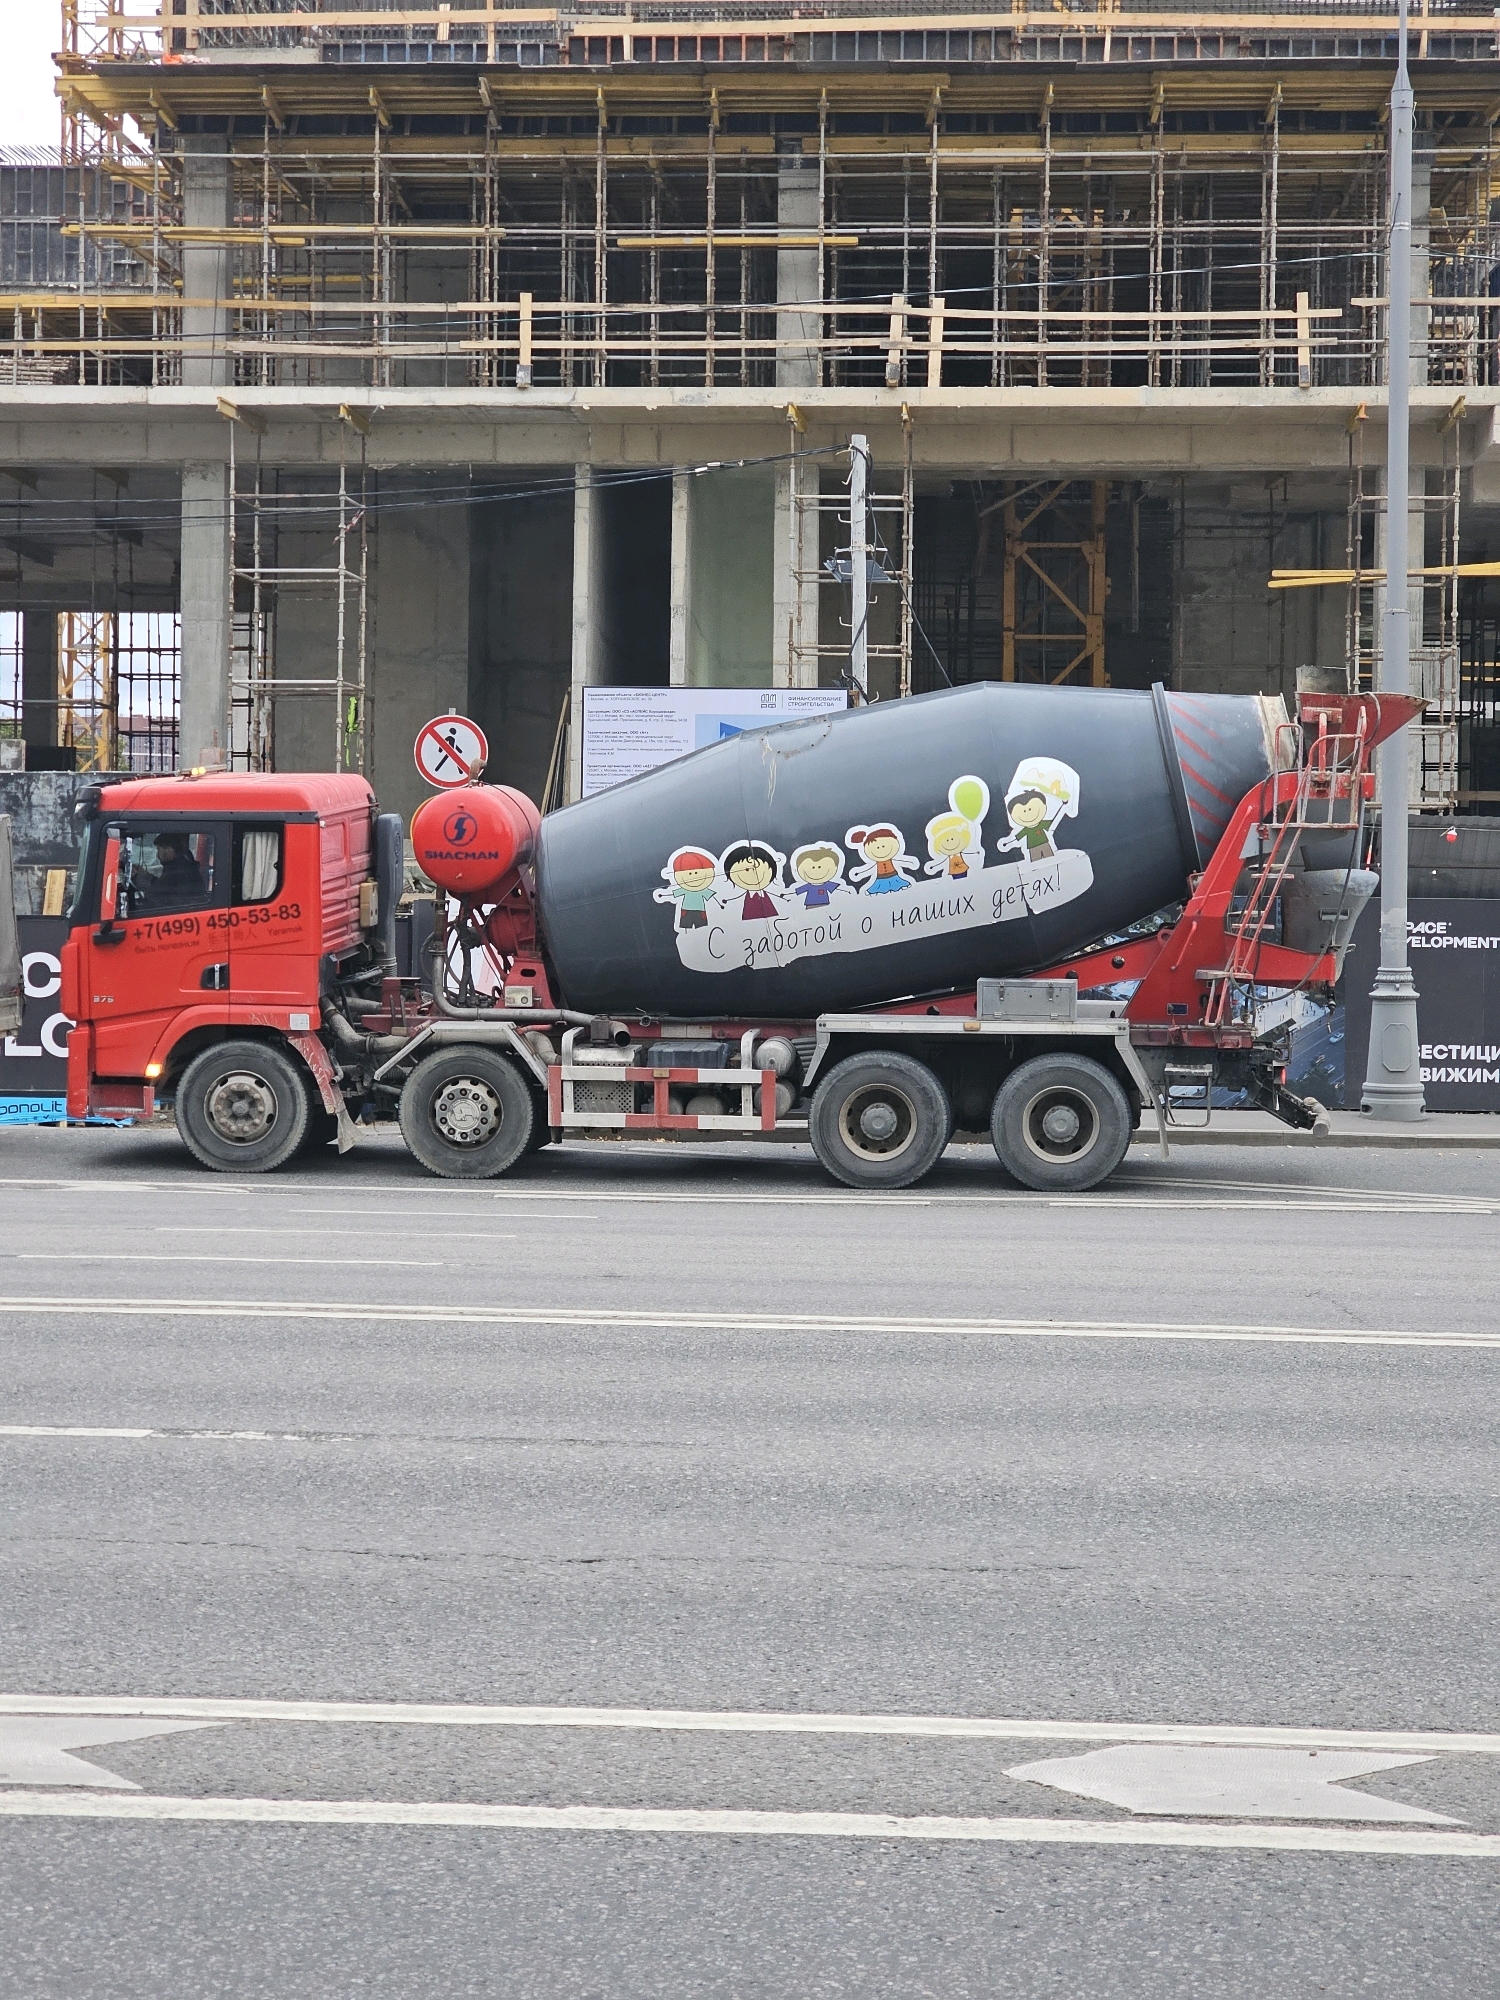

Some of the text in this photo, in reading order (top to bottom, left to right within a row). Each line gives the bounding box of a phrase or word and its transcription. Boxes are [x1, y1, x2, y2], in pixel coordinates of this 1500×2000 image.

[424, 850, 499, 860] SHACMAN
[133, 903, 301, 940] +7(499) 450-53-83
[708, 863, 1061, 966] С заботой о наших детях!
